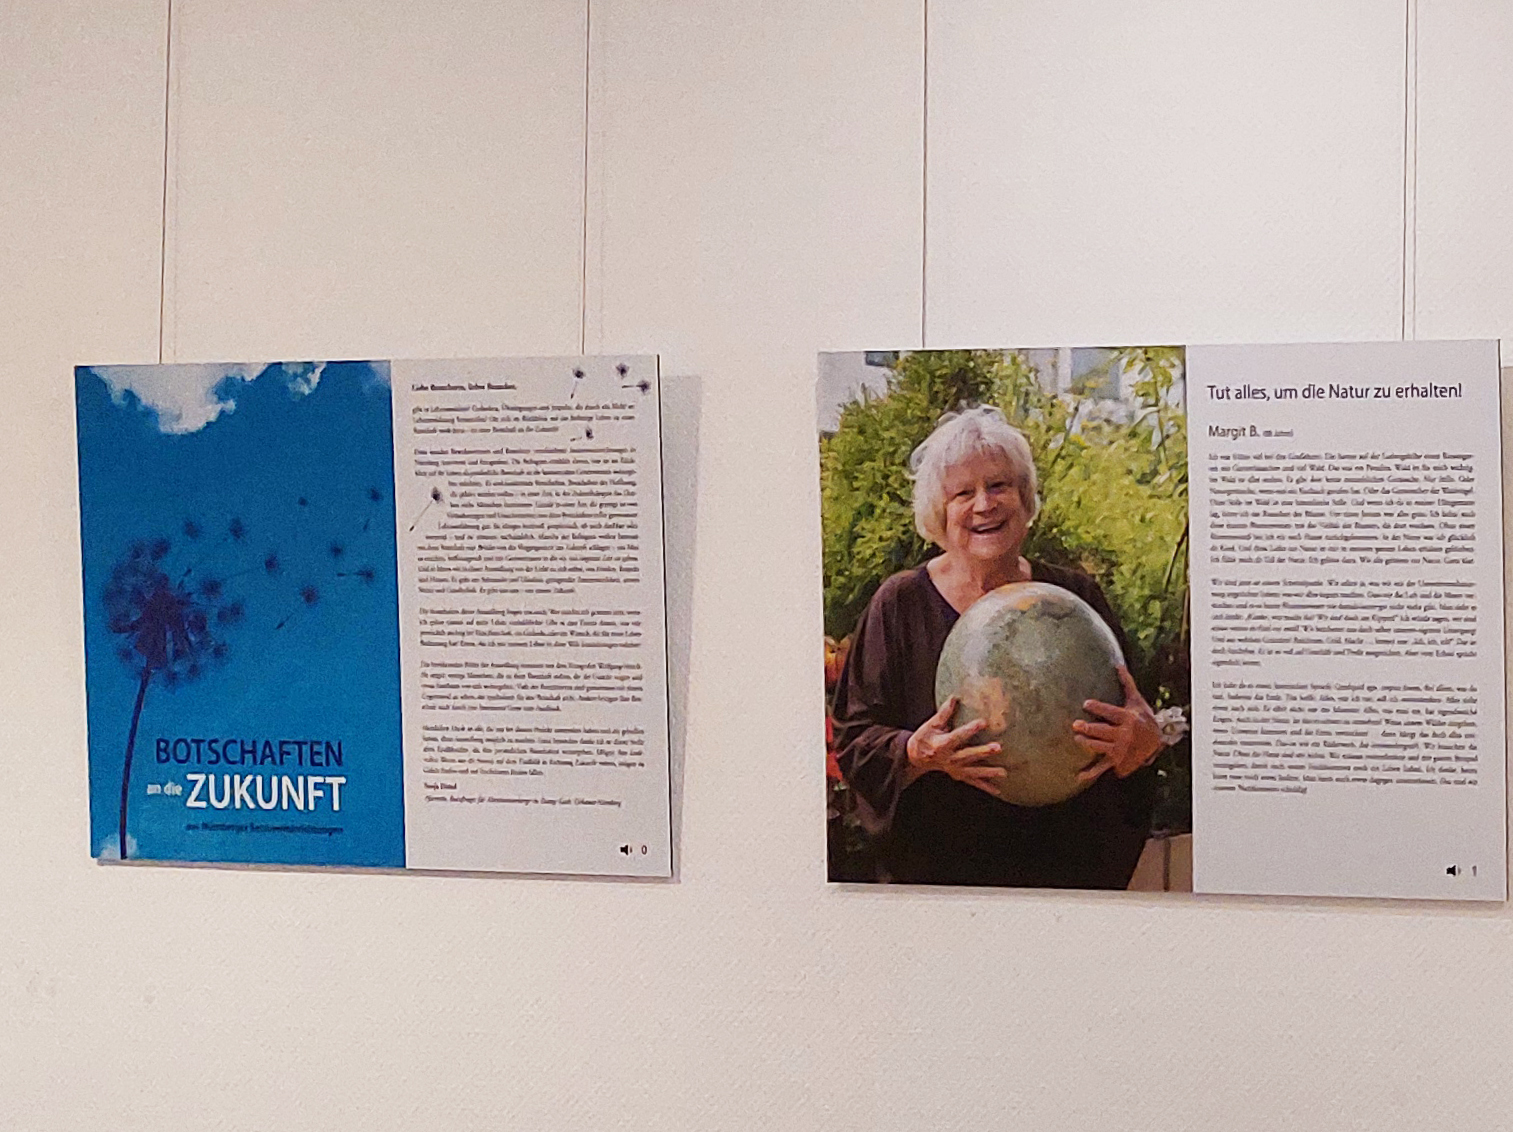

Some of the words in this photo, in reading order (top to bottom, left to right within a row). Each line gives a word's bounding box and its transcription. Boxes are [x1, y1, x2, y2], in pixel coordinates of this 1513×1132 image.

[1207, 385, 1230, 400] Tut
[1234, 384, 1270, 402] alles,
[1274, 387, 1298, 399] um
[1301, 384, 1325, 399] die
[1328, 384, 1369, 399] Natur
[1373, 386, 1391, 399] zu
[1395, 382, 1462, 399] erhalten!
[1208, 425, 1246, 440] Margit
[156, 738, 343, 767] BOTSCHAFTEN
[163, 781, 182, 796] die
[186, 773, 347, 811] ZUKUNFT
[641, 844, 648, 855] 0
[1472, 865, 1478, 877] 1
